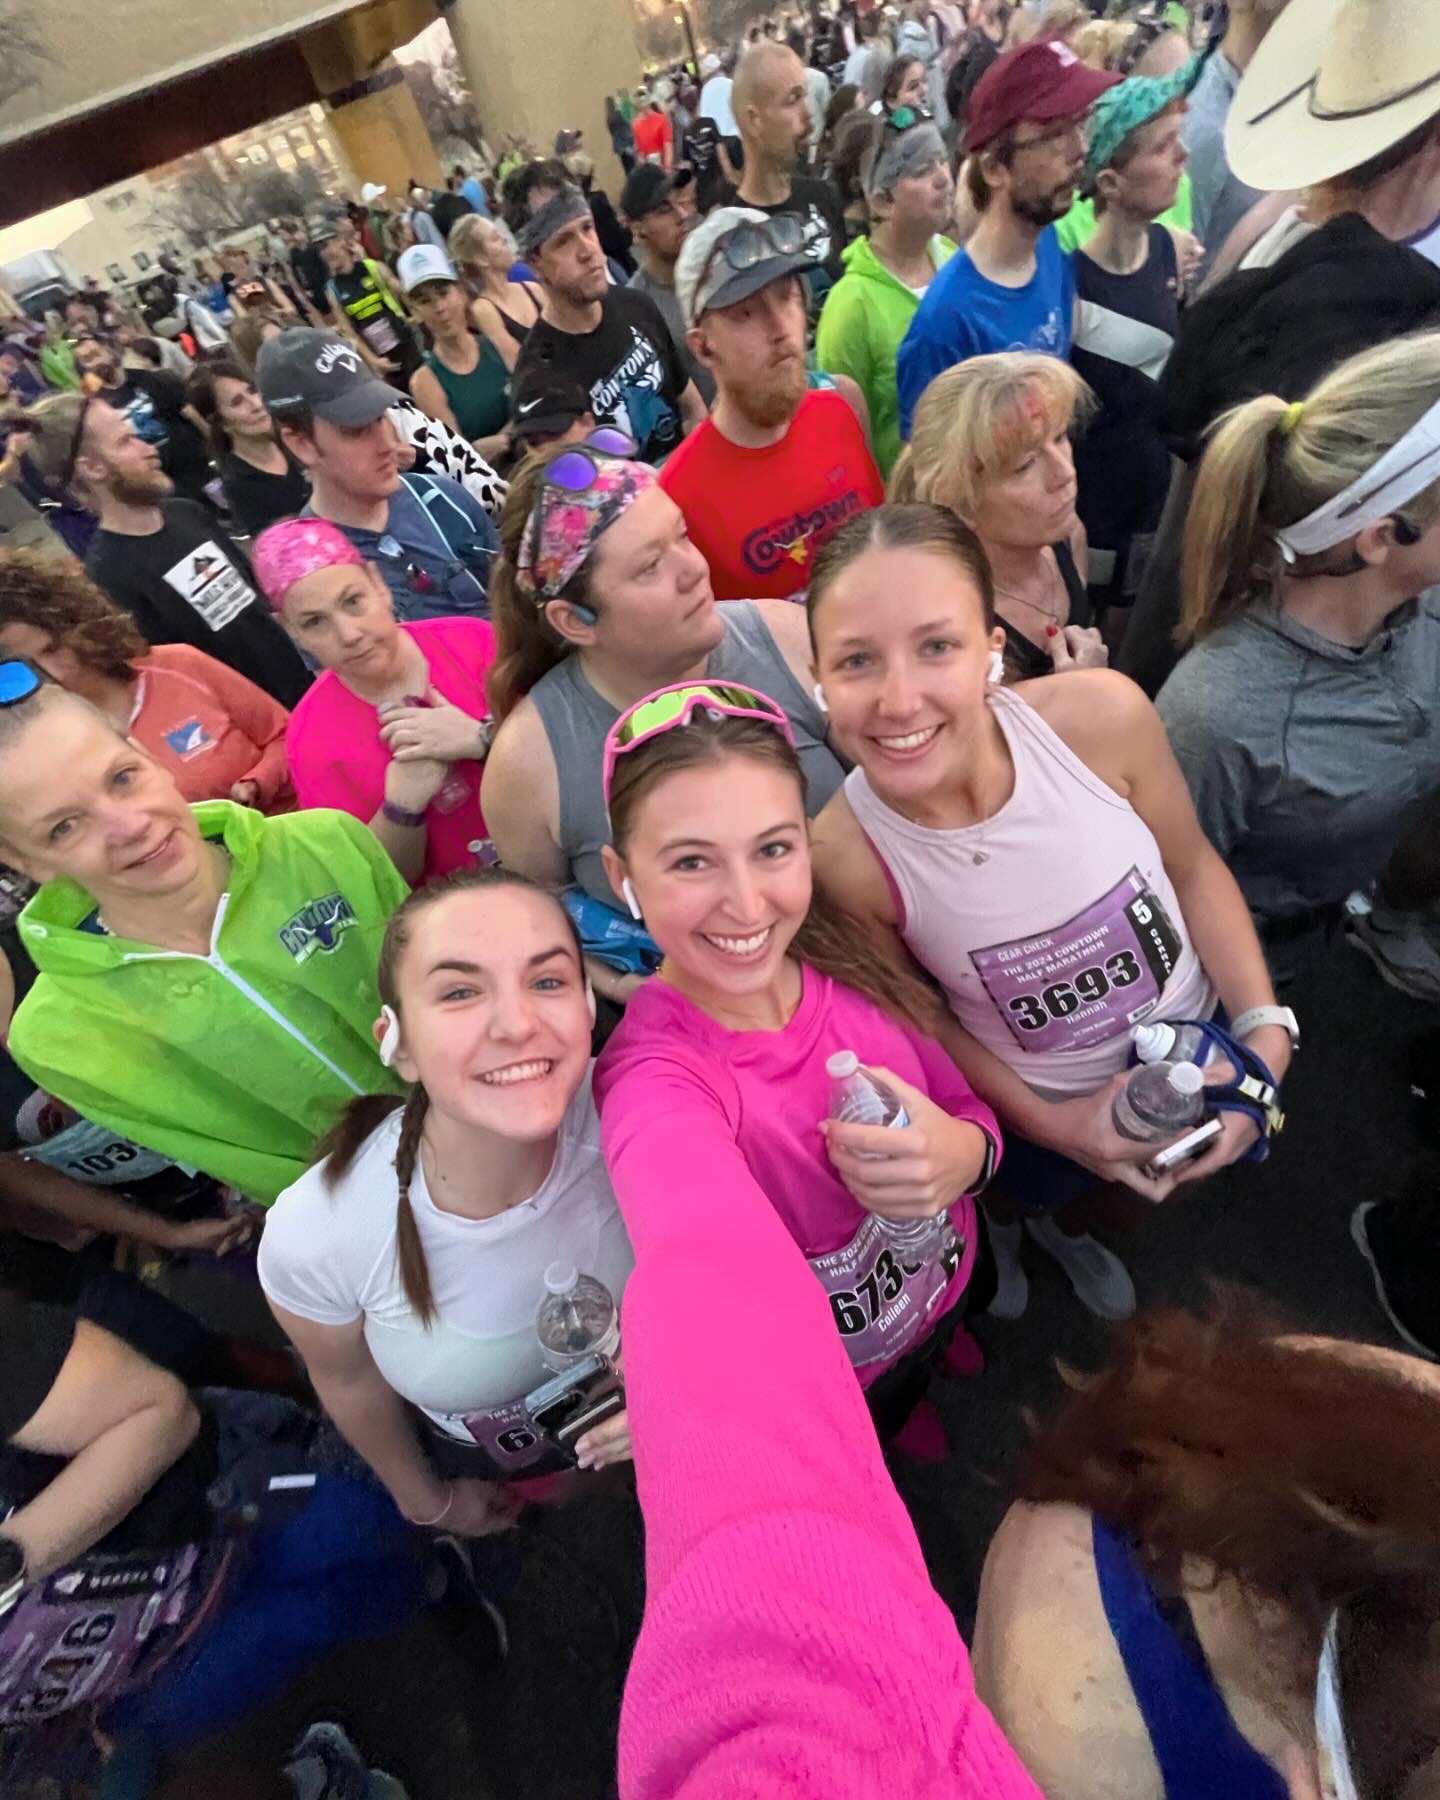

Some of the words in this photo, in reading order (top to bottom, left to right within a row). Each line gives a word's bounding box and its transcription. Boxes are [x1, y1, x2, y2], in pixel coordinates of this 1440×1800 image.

[1131, 898, 1153, 925] 5
[997, 944, 1023, 962] GEAR
[1024, 937, 1055, 957] CHECK
[1004, 964, 1024, 978] THE
[1026, 953, 1053, 970] 2024
[1054, 925, 1110, 958] COWTOWN
[1016, 968, 1045, 984] HALF
[1047, 940, 1105, 973] MARATHON
[1008, 949, 1143, 1032] 3693
[1066, 1000, 1108, 1025] Hannah
[67, 1142, 148, 1176] 103
[815, 1257, 838, 1270] THE
[830, 1261, 858, 1278] HALF
[829, 1248, 922, 1336] 673
[878, 1293, 911, 1332] Colleen
